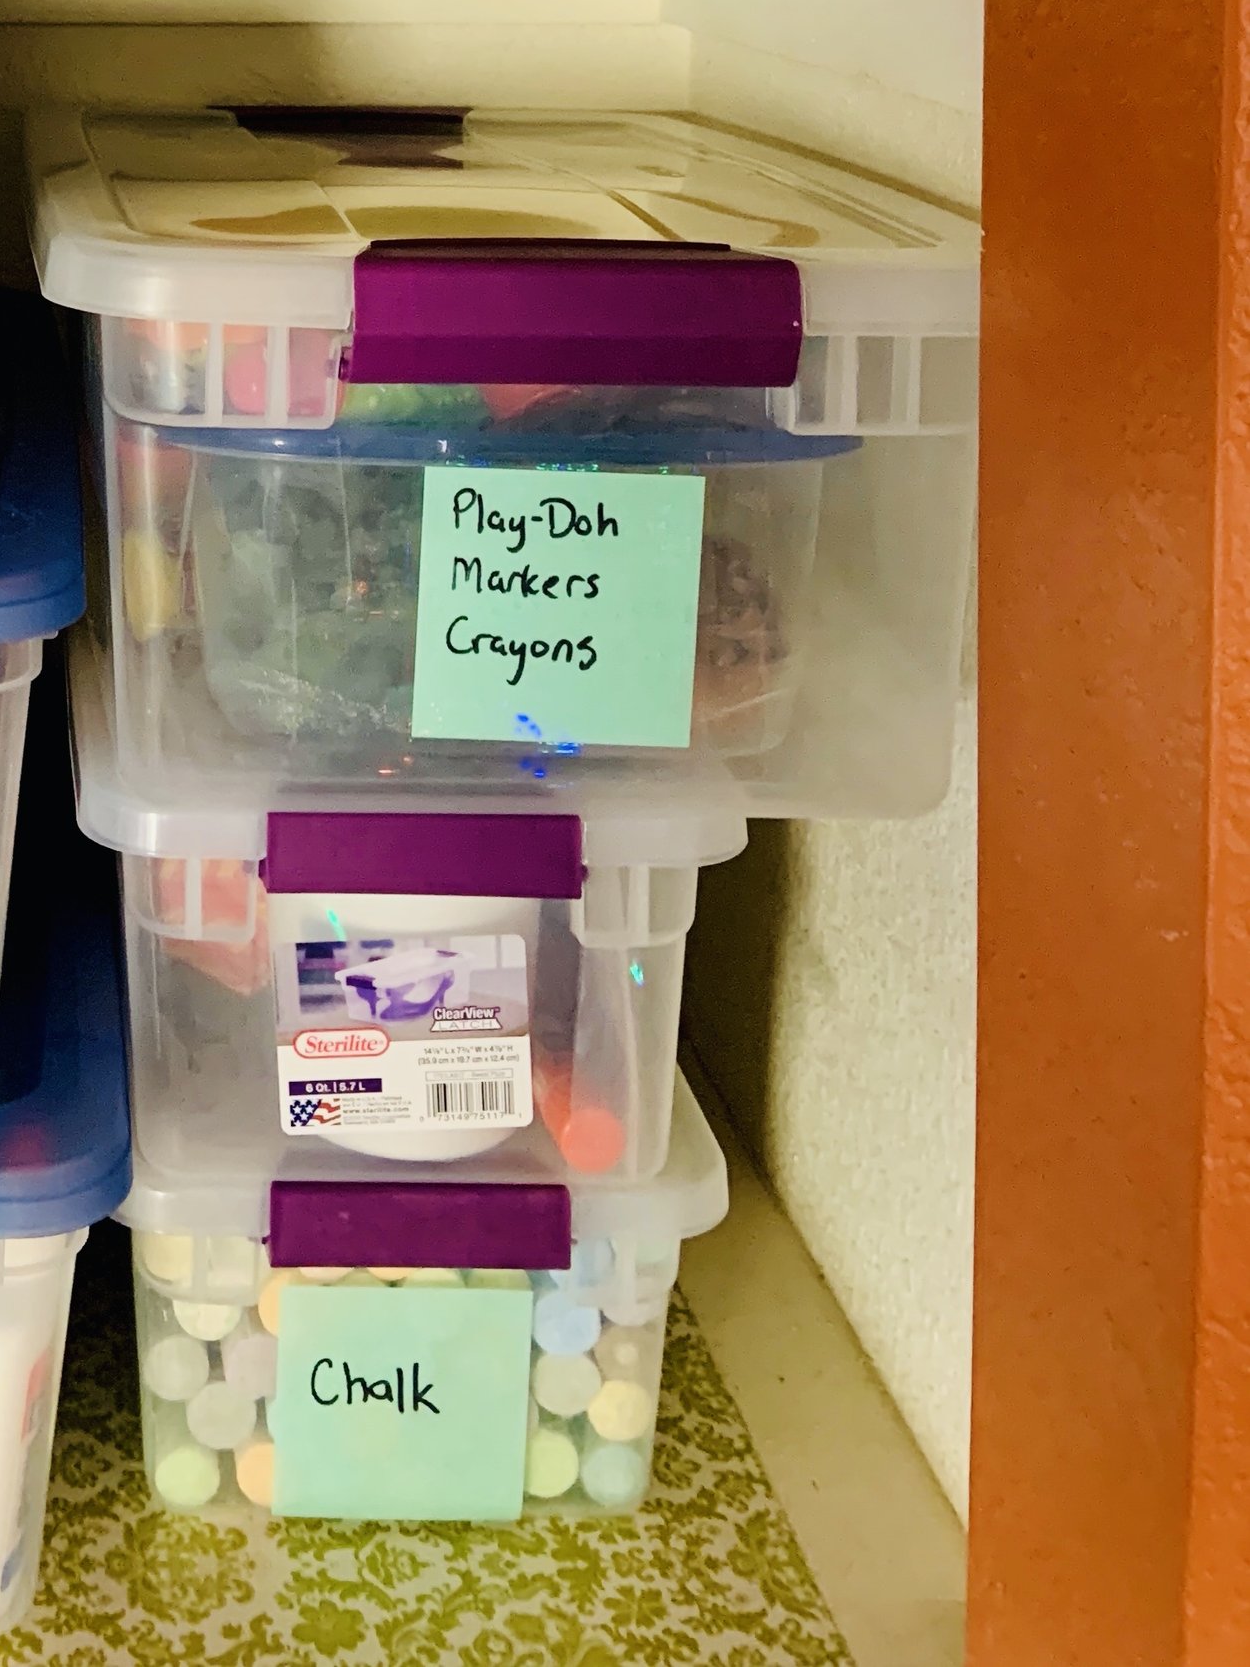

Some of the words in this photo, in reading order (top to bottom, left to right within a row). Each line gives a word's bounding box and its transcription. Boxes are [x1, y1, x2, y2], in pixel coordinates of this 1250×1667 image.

[453, 487, 619, 553] Play-Doh
[451, 556, 600, 599] Markers
[446, 615, 598, 686] Crayons
[433, 1006, 495, 1020] ClearView
[438, 1021, 493, 1030] LATCH
[305, 1034, 379, 1054] Sterilite
[311, 1358, 440, 1414] Chalk
